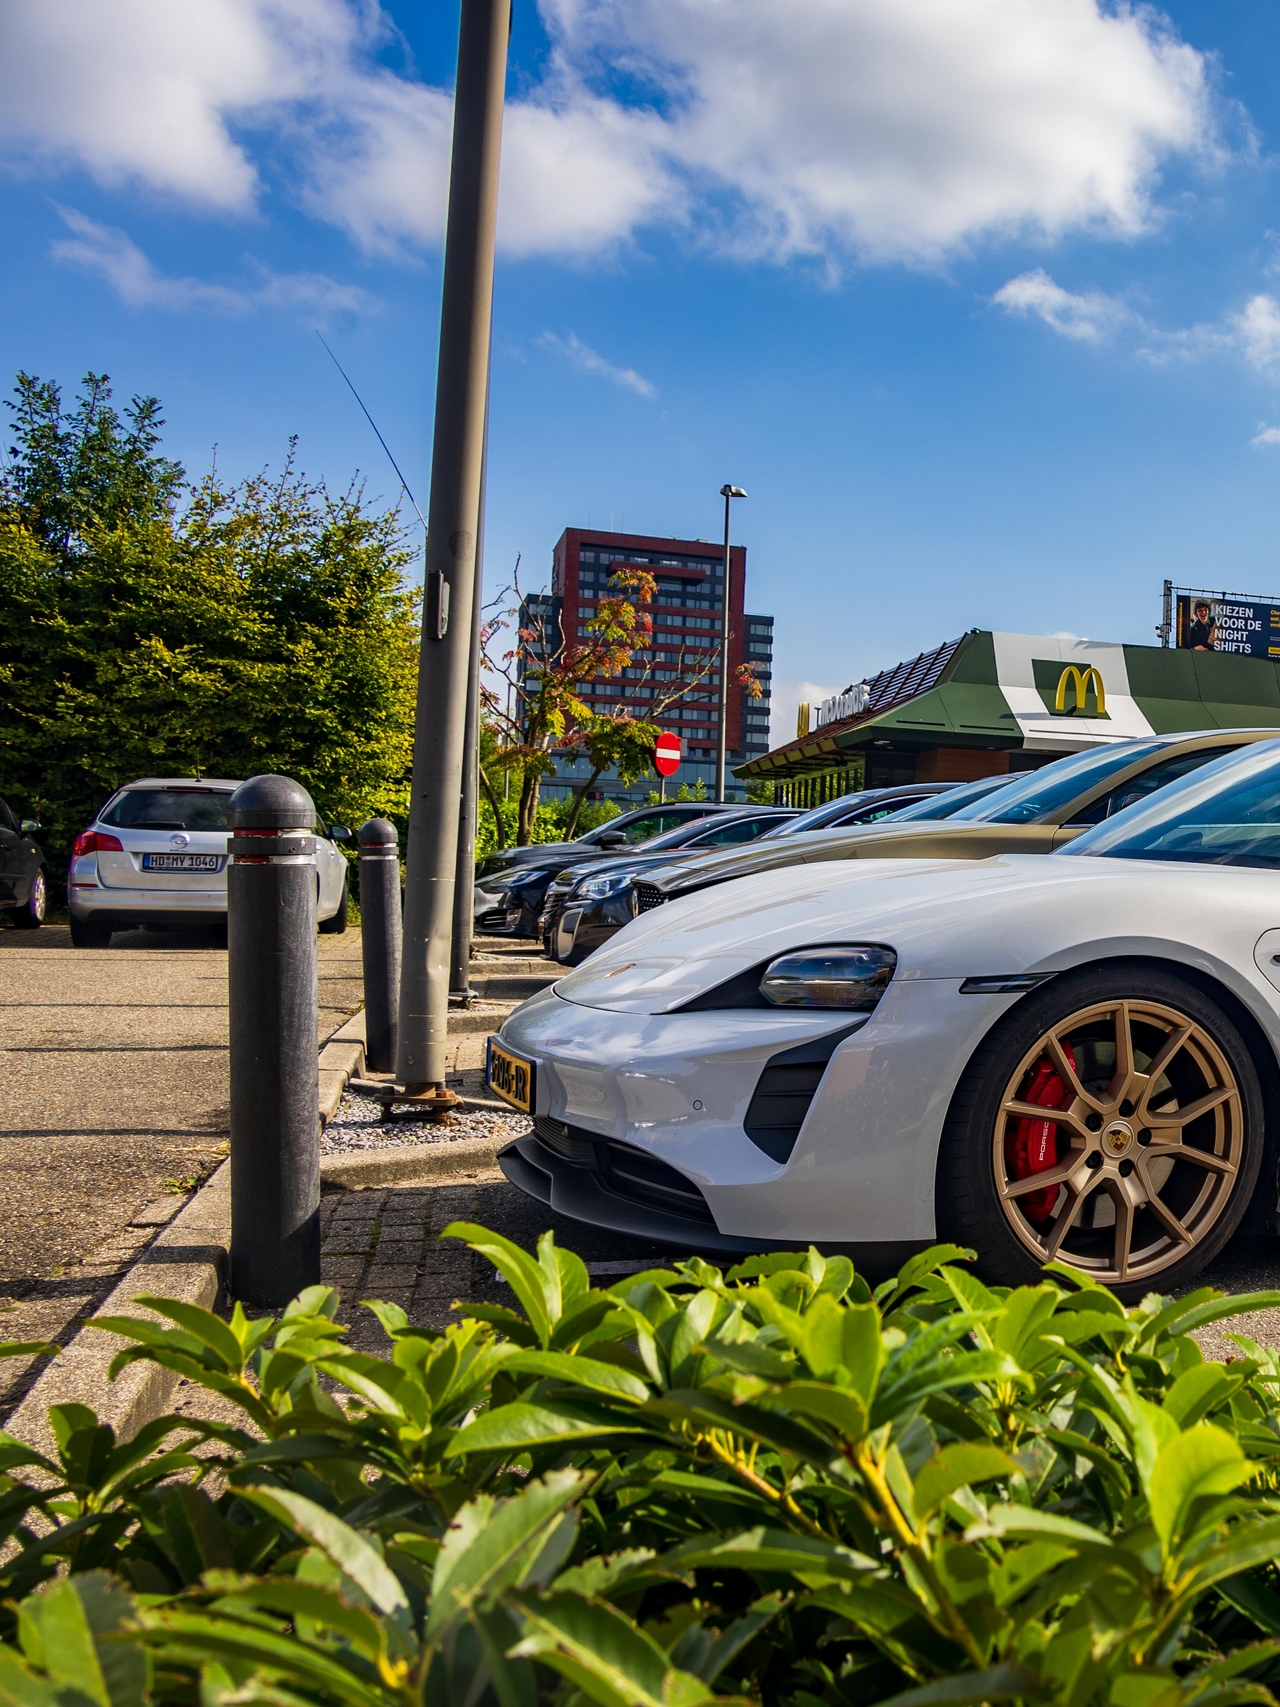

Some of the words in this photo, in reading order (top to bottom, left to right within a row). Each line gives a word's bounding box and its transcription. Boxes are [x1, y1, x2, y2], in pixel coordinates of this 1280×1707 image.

[1215, 604, 1254, 618] KIEZEN
[1214, 616, 1246, 629] VOOR
[1247, 619, 1262, 631] DE
[1214, 628, 1249, 641] NIGHT
[1213, 640, 1252, 654] SHIFTS
[151, 856, 165, 866] HD
[171, 856, 186, 866] MY
[188, 856, 215, 867] 1046
